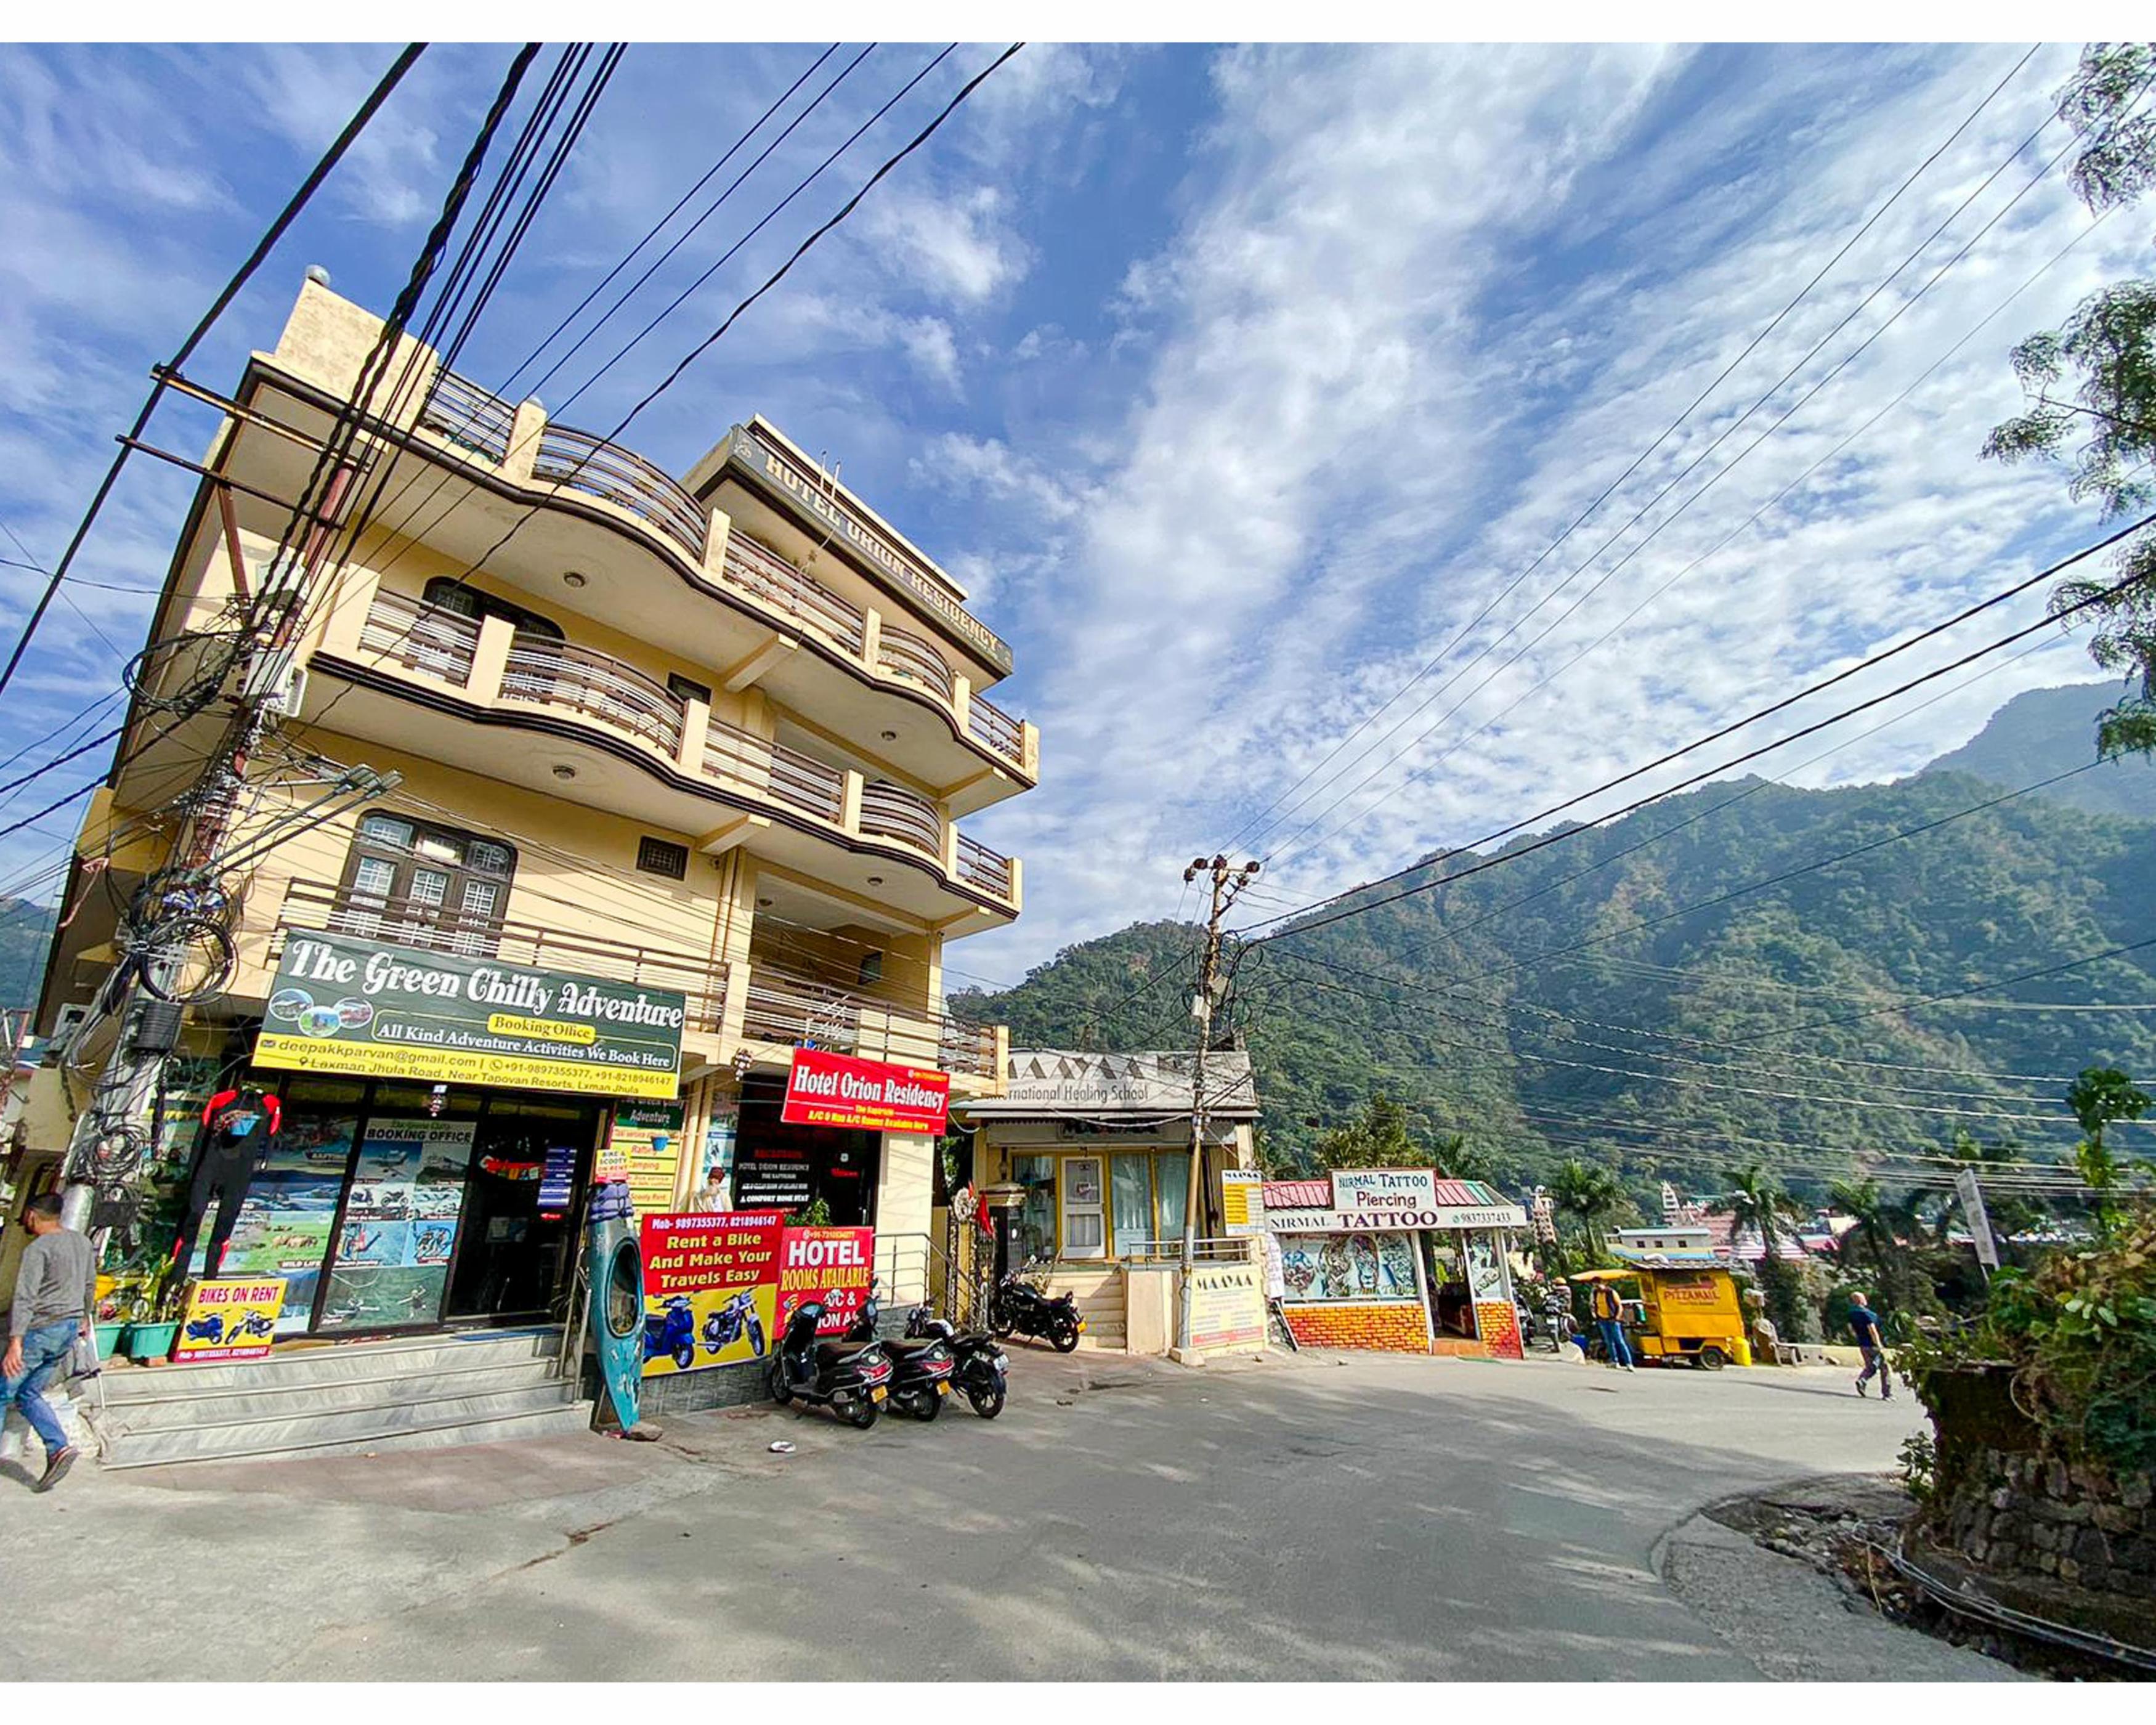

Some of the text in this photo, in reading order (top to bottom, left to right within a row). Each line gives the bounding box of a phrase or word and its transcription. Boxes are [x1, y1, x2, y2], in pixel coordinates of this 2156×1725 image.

[289, 940, 684, 1028] The Green Chilly Adventure
[494, 1017, 590, 1039] Booking Office
[278, 1040, 476, 1068] deepakkparvan@gmail.com
[377, 1023, 670, 1068] All Kind Adventure Activities We Book Here
[368, 1062, 405, 1074] Jhula
[408, 1066, 445, 1080] Road,
[448, 1070, 479, 1081] Near
[480, 1073, 529, 1087] Tapovan
[612, 1082, 639, 1095] Jhula
[793, 1065, 946, 1114] Hotel Orion Residency
[989, 1085, 1148, 1103] rnational Healing School
[366, 1129, 472, 1142] BOOKING OFFICE
[1378, 1174, 1428, 1188] TATTOO
[1356, 1191, 1417, 1209] Piercing
[1270, 1216, 1331, 1228] NIRMAL
[1337, 1211, 1438, 1228] TATTOO
[667, 1233, 761, 1249] Rent a Bike
[649, 1250, 772, 1270] And Make Your
[788, 1240, 865, 1267] HOTEL
[660, 1269, 760, 1288] Travels Easy
[780, 1267, 870, 1291] ROOMS AVAILABLE
[198, 1286, 279, 1304] BIKES ON RENT
[846, 1291, 856, 1306] &
